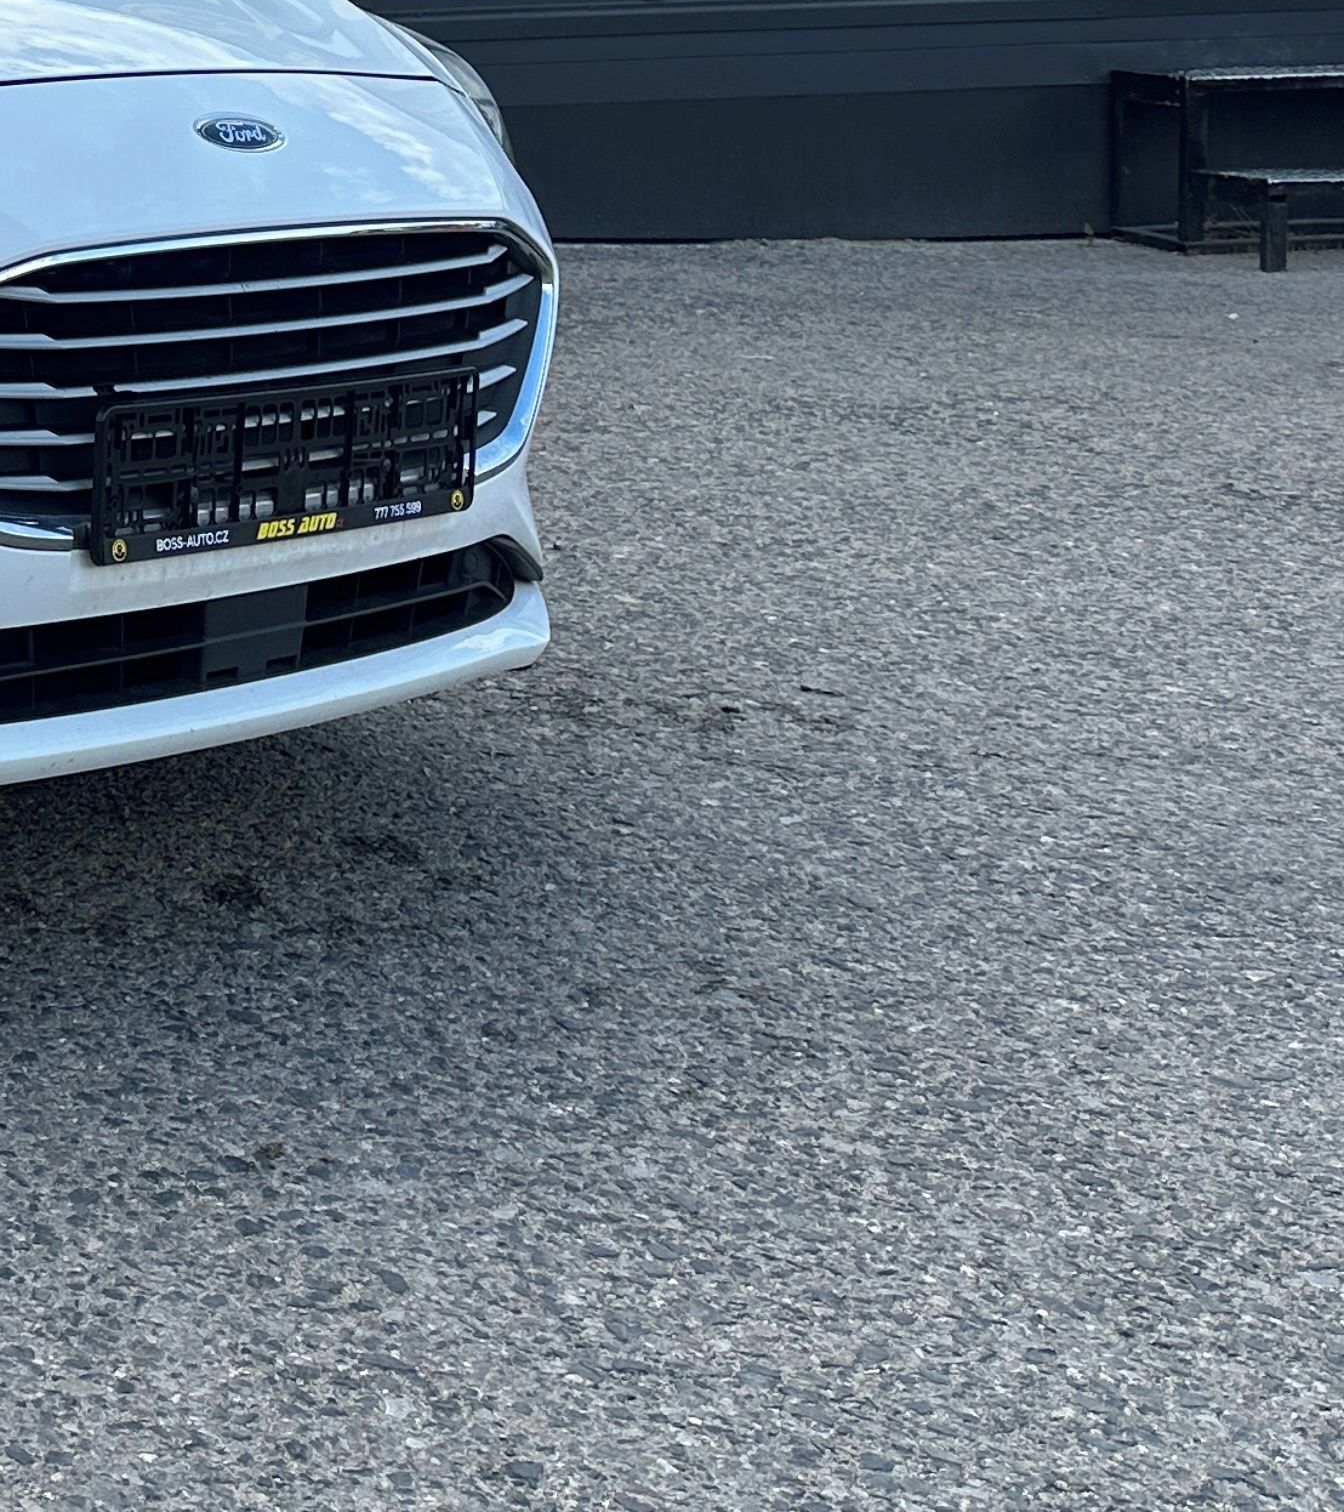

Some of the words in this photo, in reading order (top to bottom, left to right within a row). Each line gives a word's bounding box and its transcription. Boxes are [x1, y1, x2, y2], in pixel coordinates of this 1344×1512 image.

[215, 119, 267, 143] Ford
[256, 518, 296, 540] BOSS
[297, 512, 337, 535] AUTO
[156, 529, 230, 552] BOSS-AUTO.CZ
